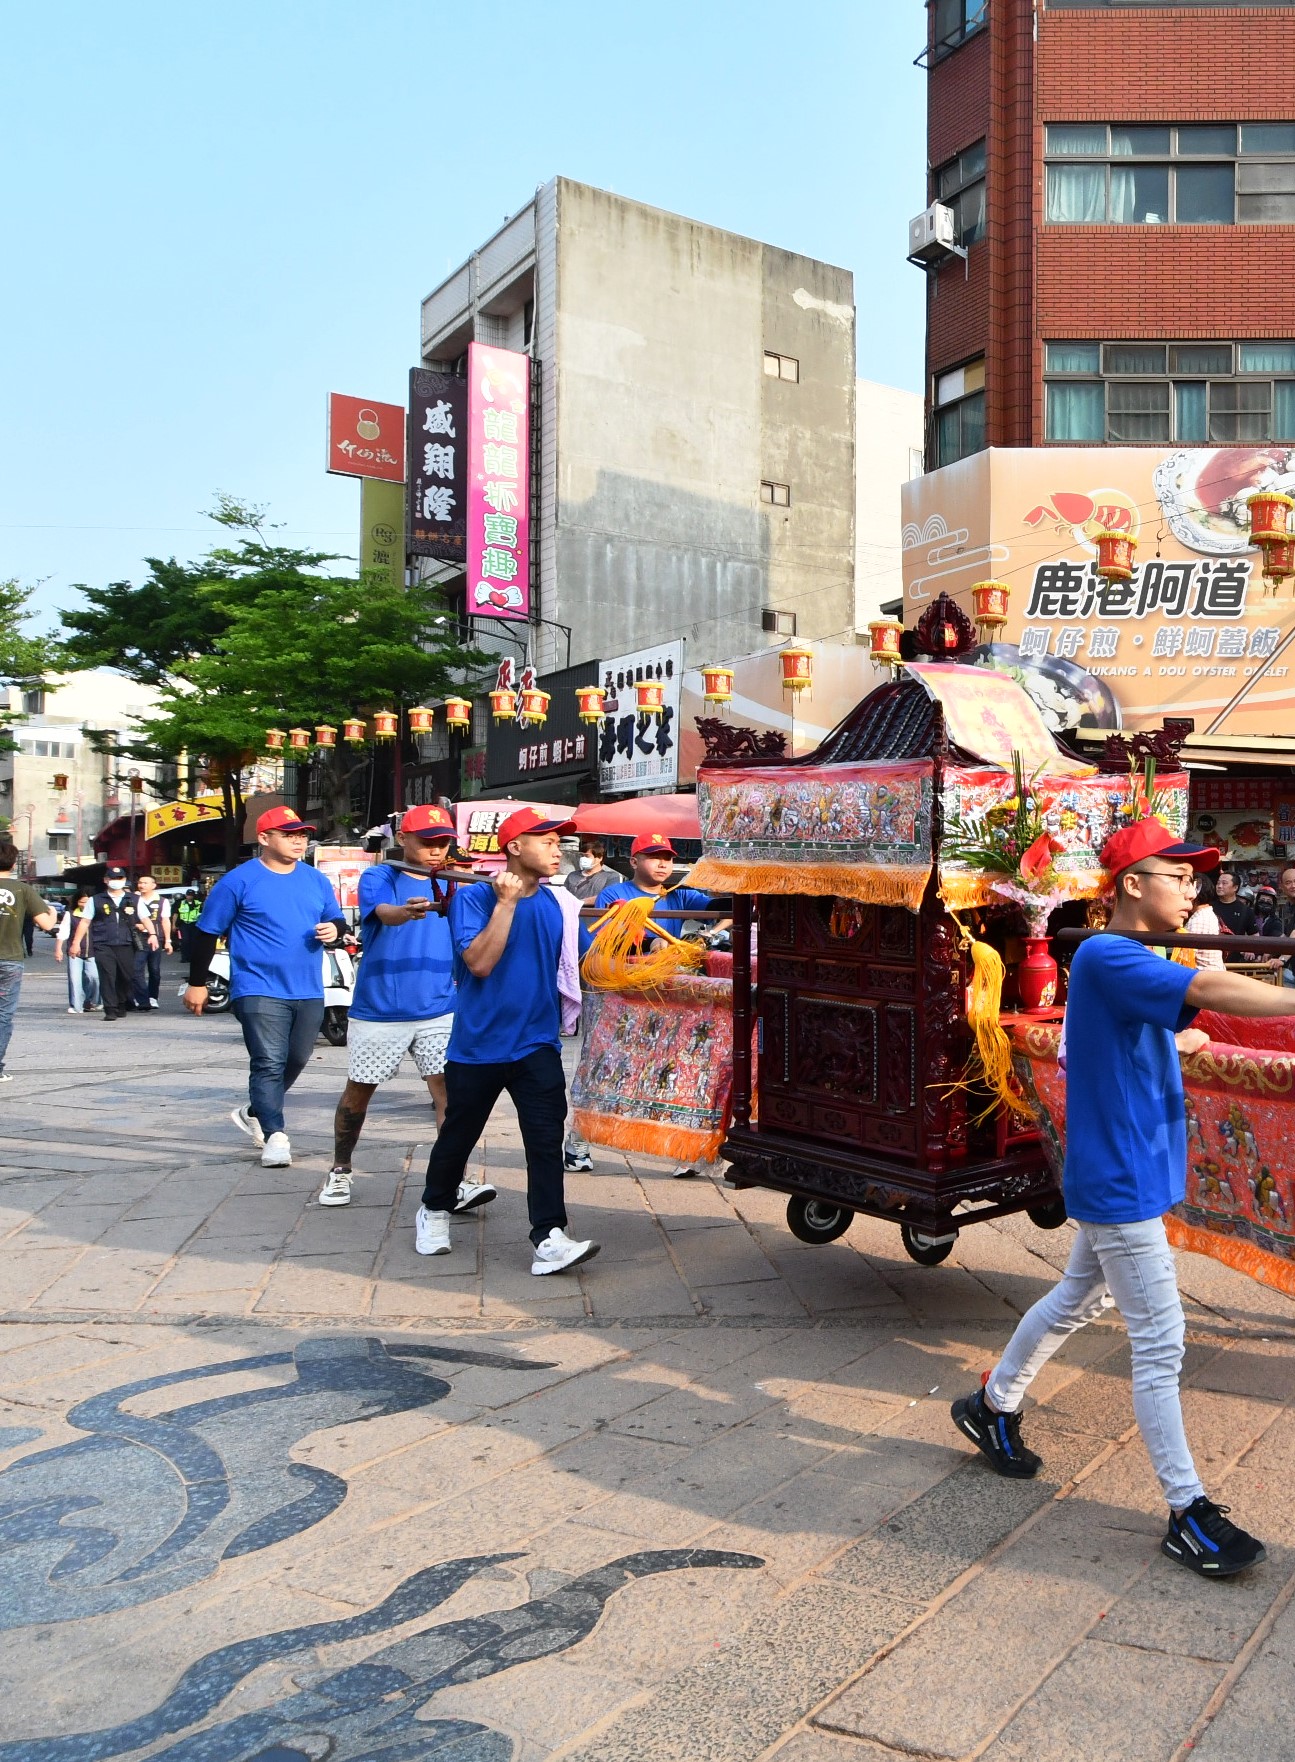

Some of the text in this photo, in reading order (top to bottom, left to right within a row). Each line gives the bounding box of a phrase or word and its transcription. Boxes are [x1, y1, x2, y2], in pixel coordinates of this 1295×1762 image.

[1026, 560, 1251, 617] 鹿港阿道
[1086, 666, 1288, 677] LUKANG A DOU OYSTER OELET
[518, 743, 548, 771] 蚵仔煎
[552, 734, 585, 765] 蝦仁煎
